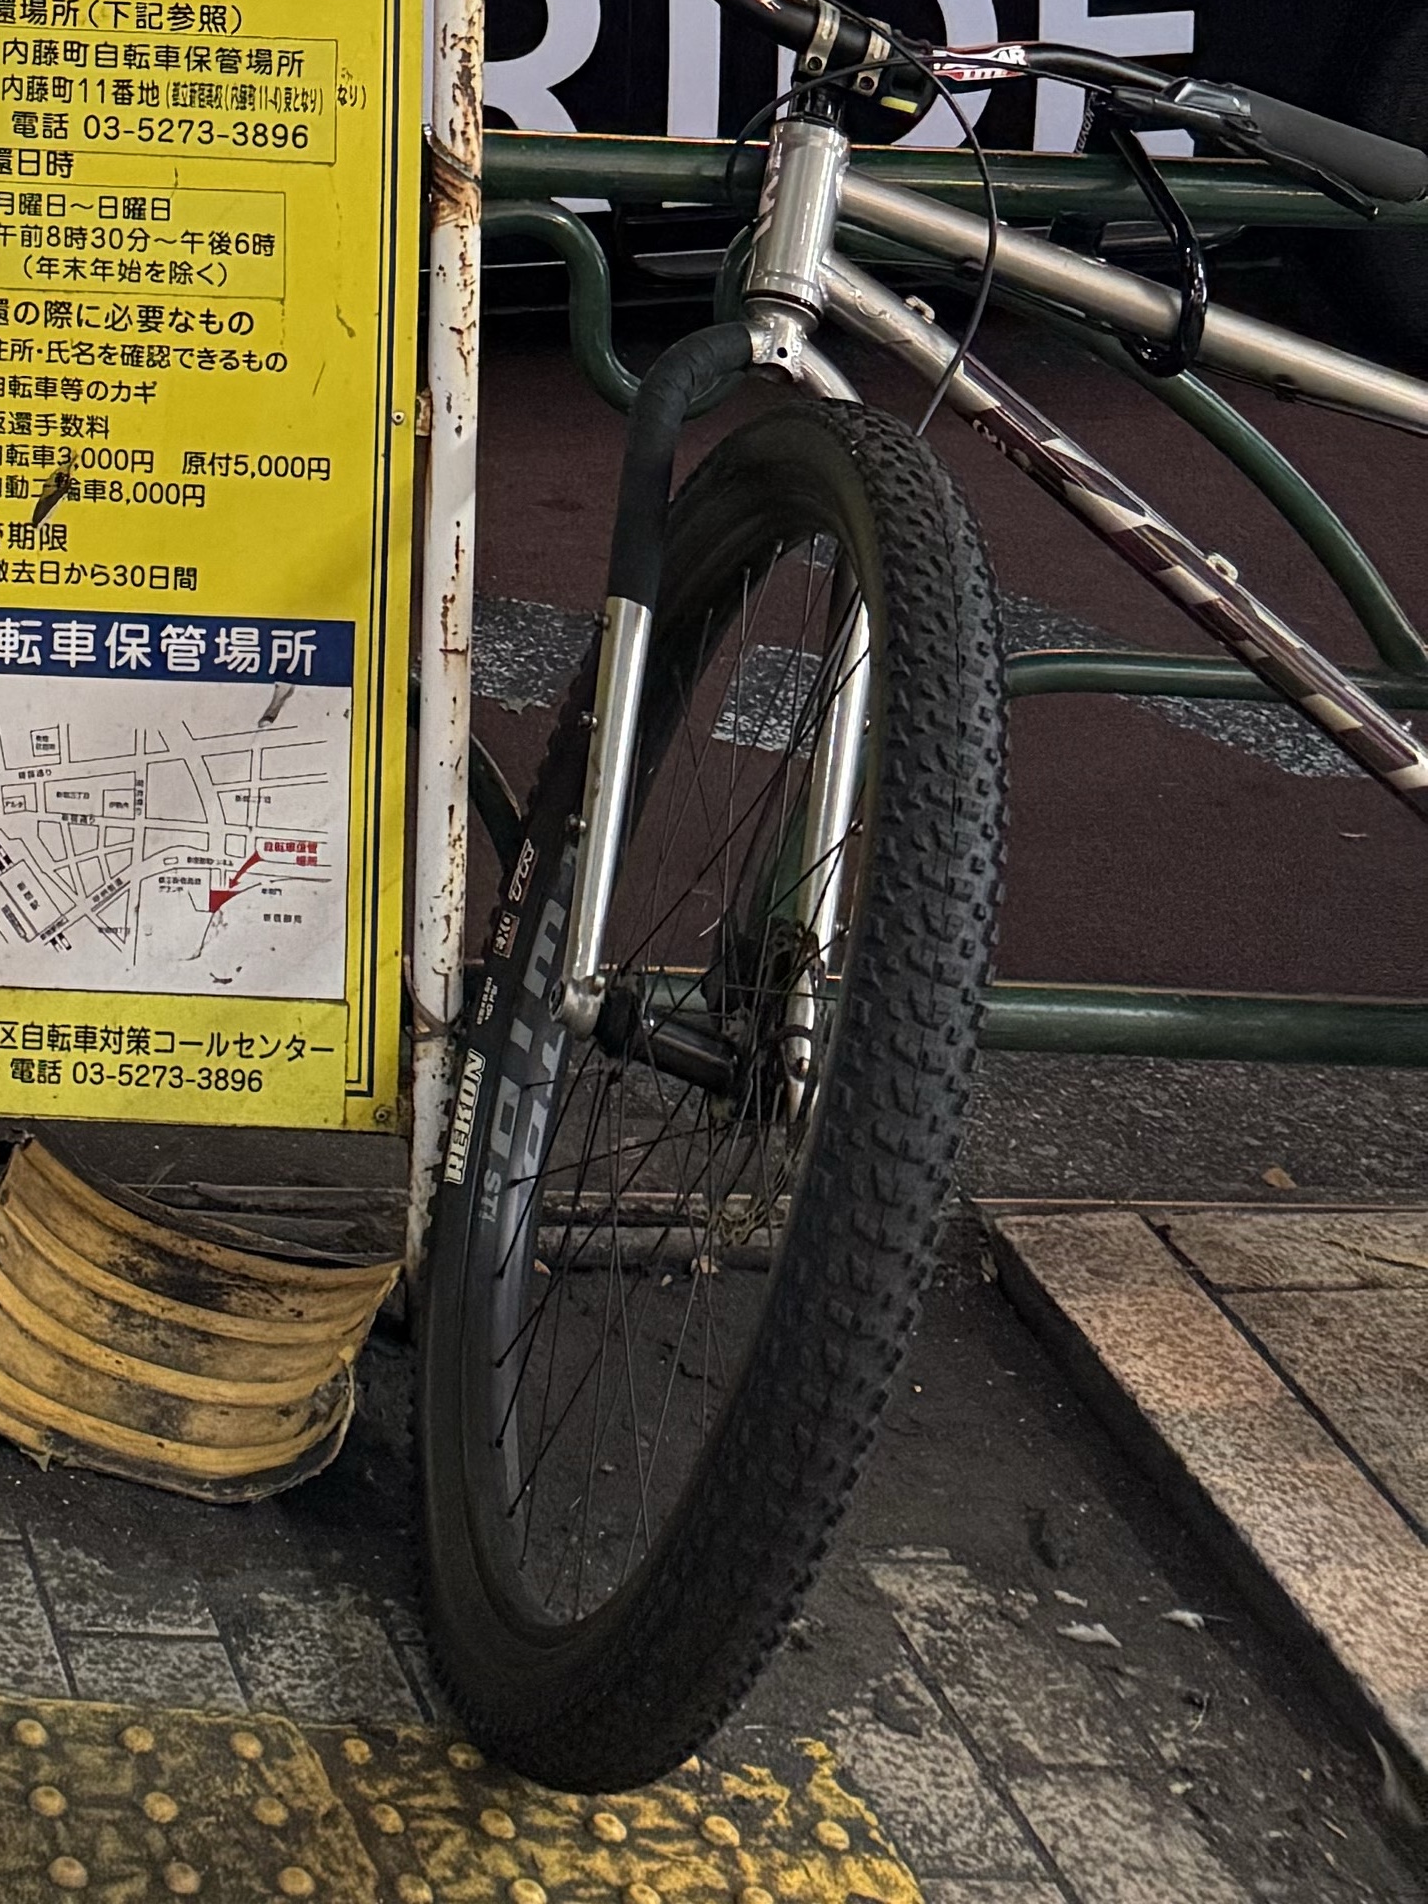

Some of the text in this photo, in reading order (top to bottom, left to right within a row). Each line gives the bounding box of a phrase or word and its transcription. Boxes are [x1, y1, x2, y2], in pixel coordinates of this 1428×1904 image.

[1, 37, 305, 79] 内藤町自転車保管場所
[0, 74, 160, 109] 内藤町11番地
[11, 111, 310, 150] 電話 03-5273-3896
[22, 256, 229, 288] (年末年始を除く)
[181, 450, 332, 482] 原付5,000円
[10, 1056, 264, 1094] 電話 03-5273-3896
[444, 1047, 487, 1183] REKON
